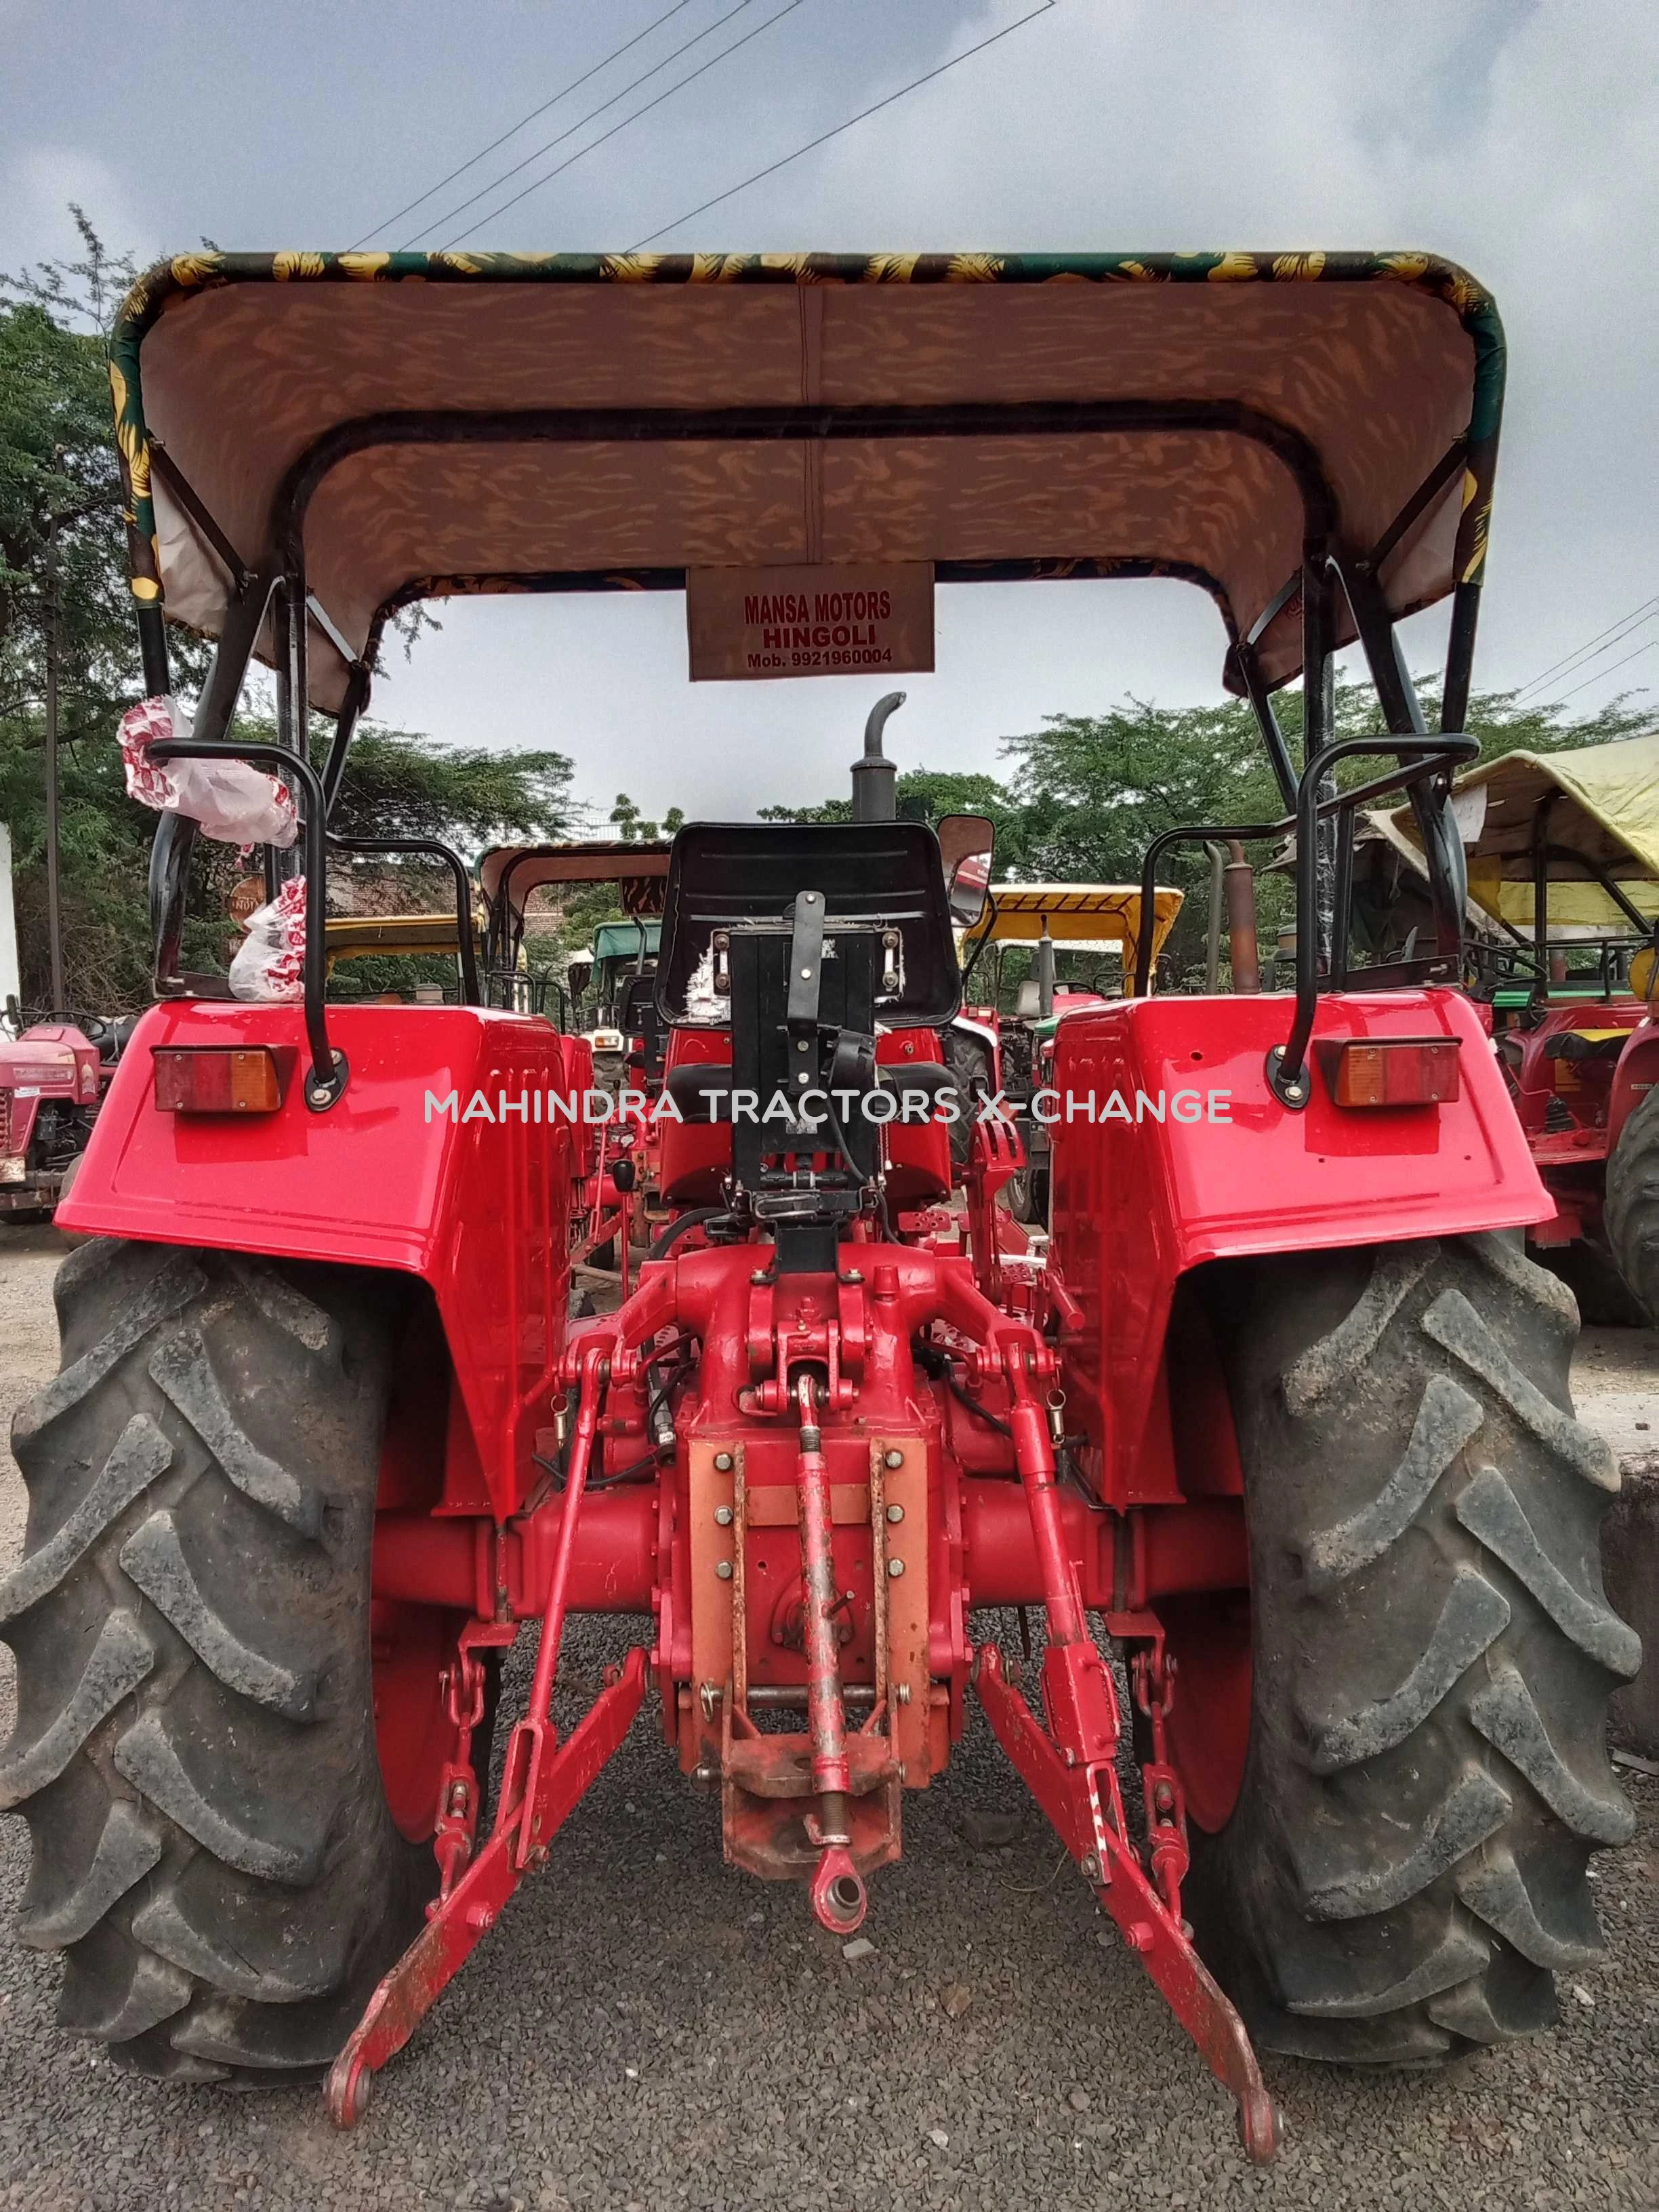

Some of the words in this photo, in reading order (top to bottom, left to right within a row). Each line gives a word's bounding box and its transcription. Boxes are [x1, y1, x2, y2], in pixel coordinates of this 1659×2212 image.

[744, 594, 810, 624] MANSA
[815, 590, 891, 622] MOTORS
[763, 624, 876, 649] HINGOLI
[747, 653, 787, 668] Mob.
[792, 649, 893, 666] 9921960004
